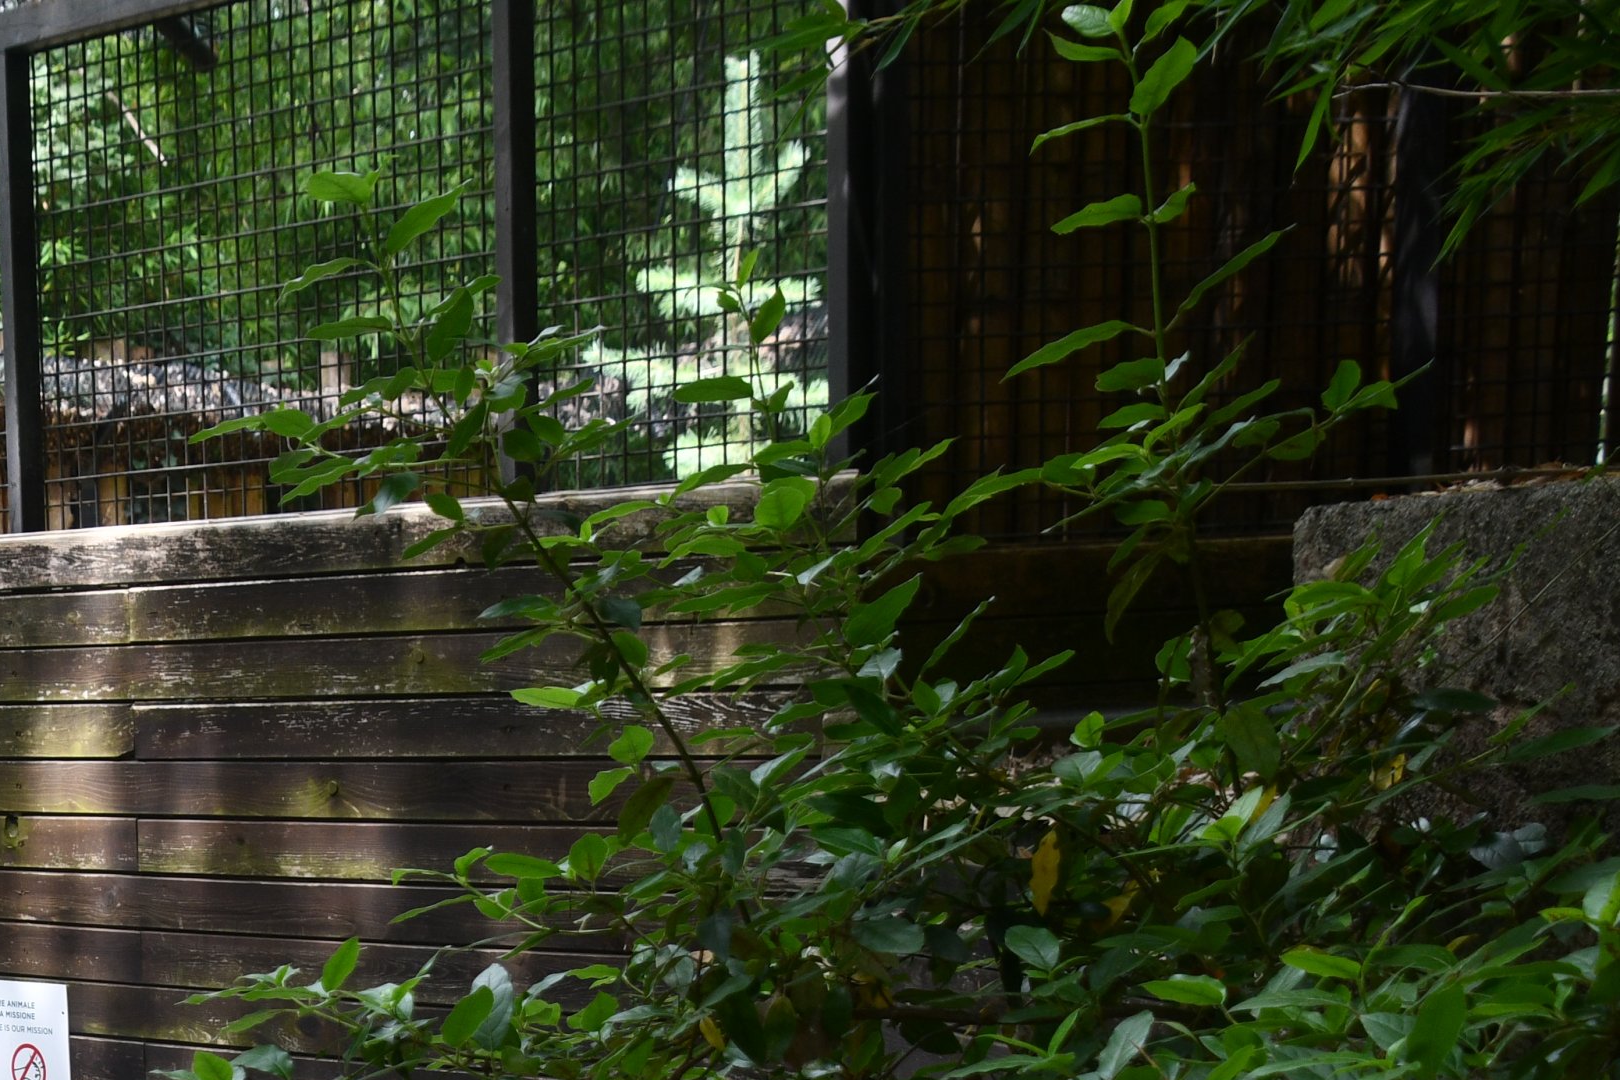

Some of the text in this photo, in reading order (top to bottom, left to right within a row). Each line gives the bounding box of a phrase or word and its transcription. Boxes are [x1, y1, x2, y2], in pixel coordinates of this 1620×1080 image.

[7, 1000, 35, 1009] ANIMALE
[6, 1011, 35, 1020] MISSIONE
[4, 1024, 10, 1032] IS
[11, 1025, 25, 1033] OUR
[26, 1026, 53, 1035] MISSION
